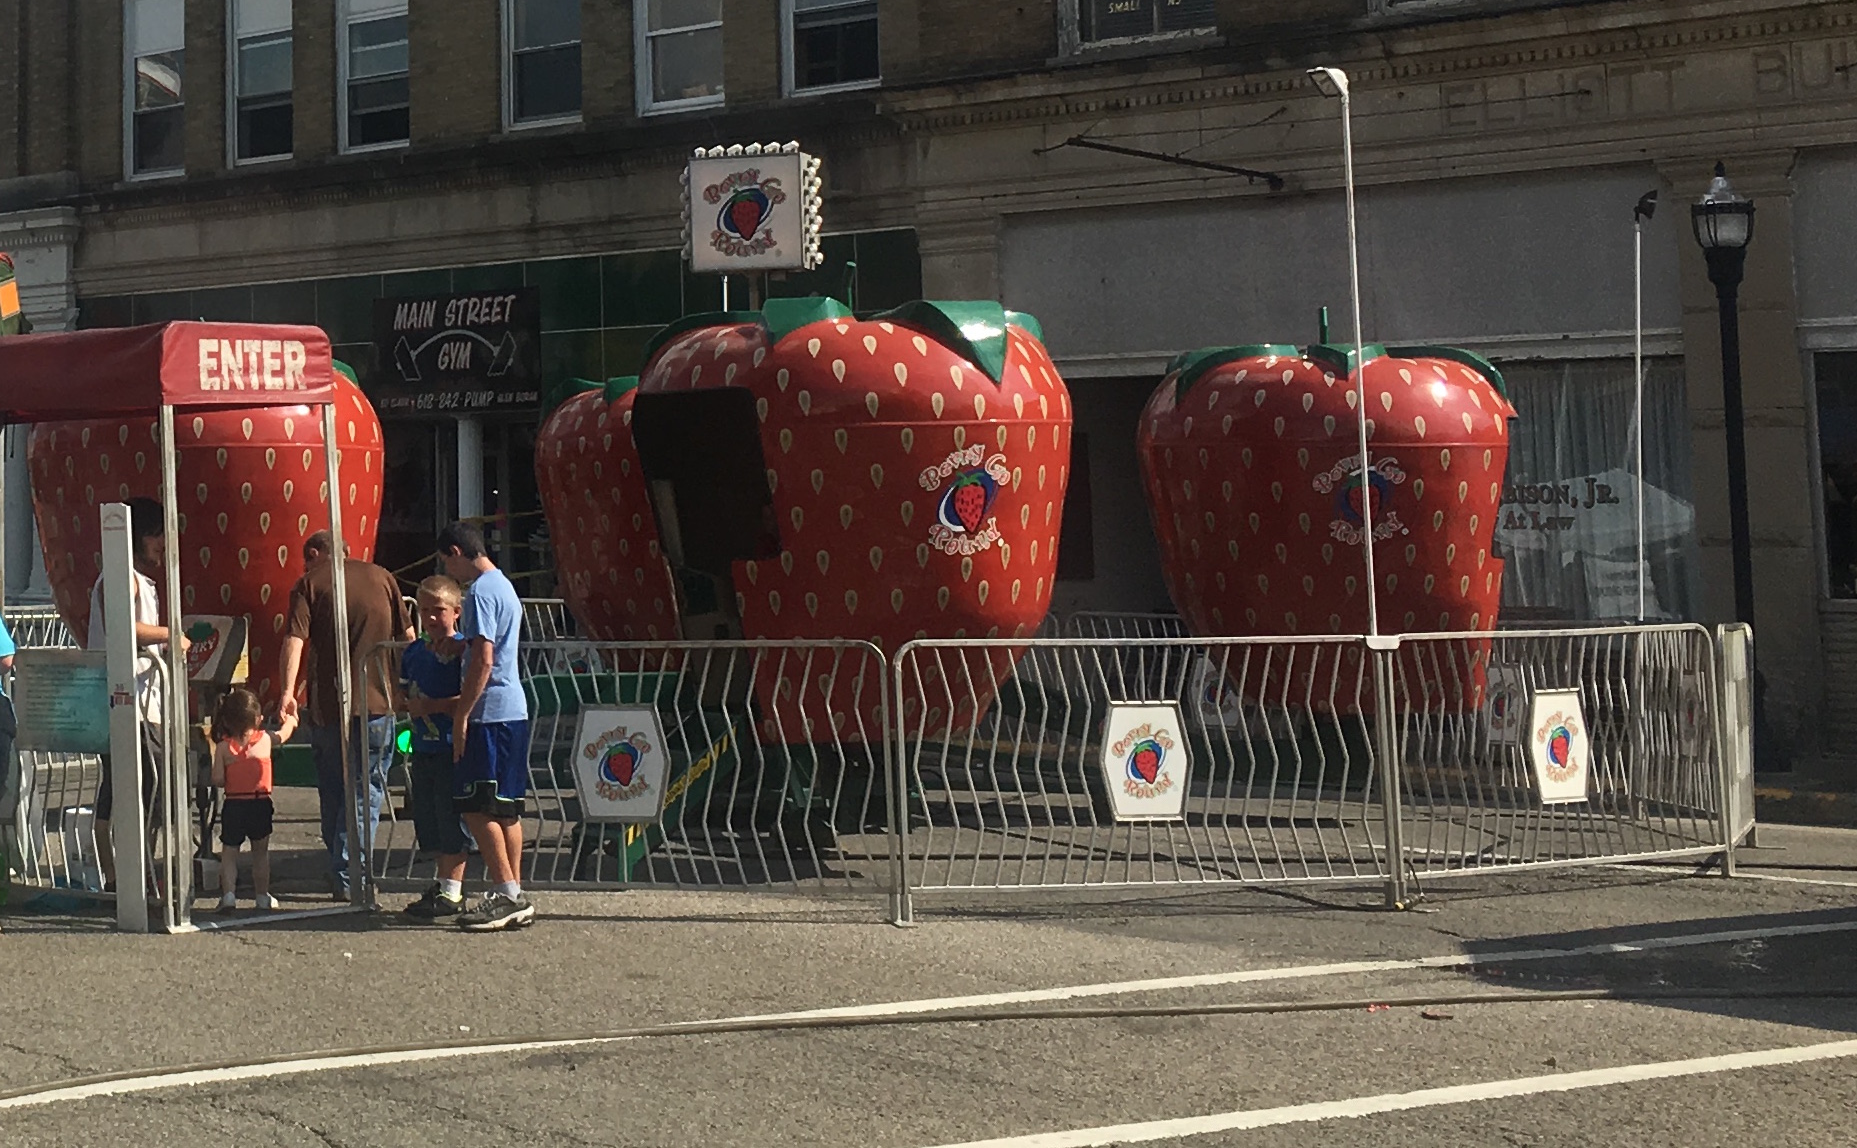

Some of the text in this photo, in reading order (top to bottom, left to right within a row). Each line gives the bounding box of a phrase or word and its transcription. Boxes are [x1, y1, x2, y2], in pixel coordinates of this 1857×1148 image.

[394, 294, 516, 330] MAIN STREET
[198, 338, 307, 391] ENTER
[438, 341, 473, 371] GYM
[919, 444, 1011, 492] Berry Go
[928, 516, 1001, 556] Round
[1503, 510, 1575, 531] At Law
